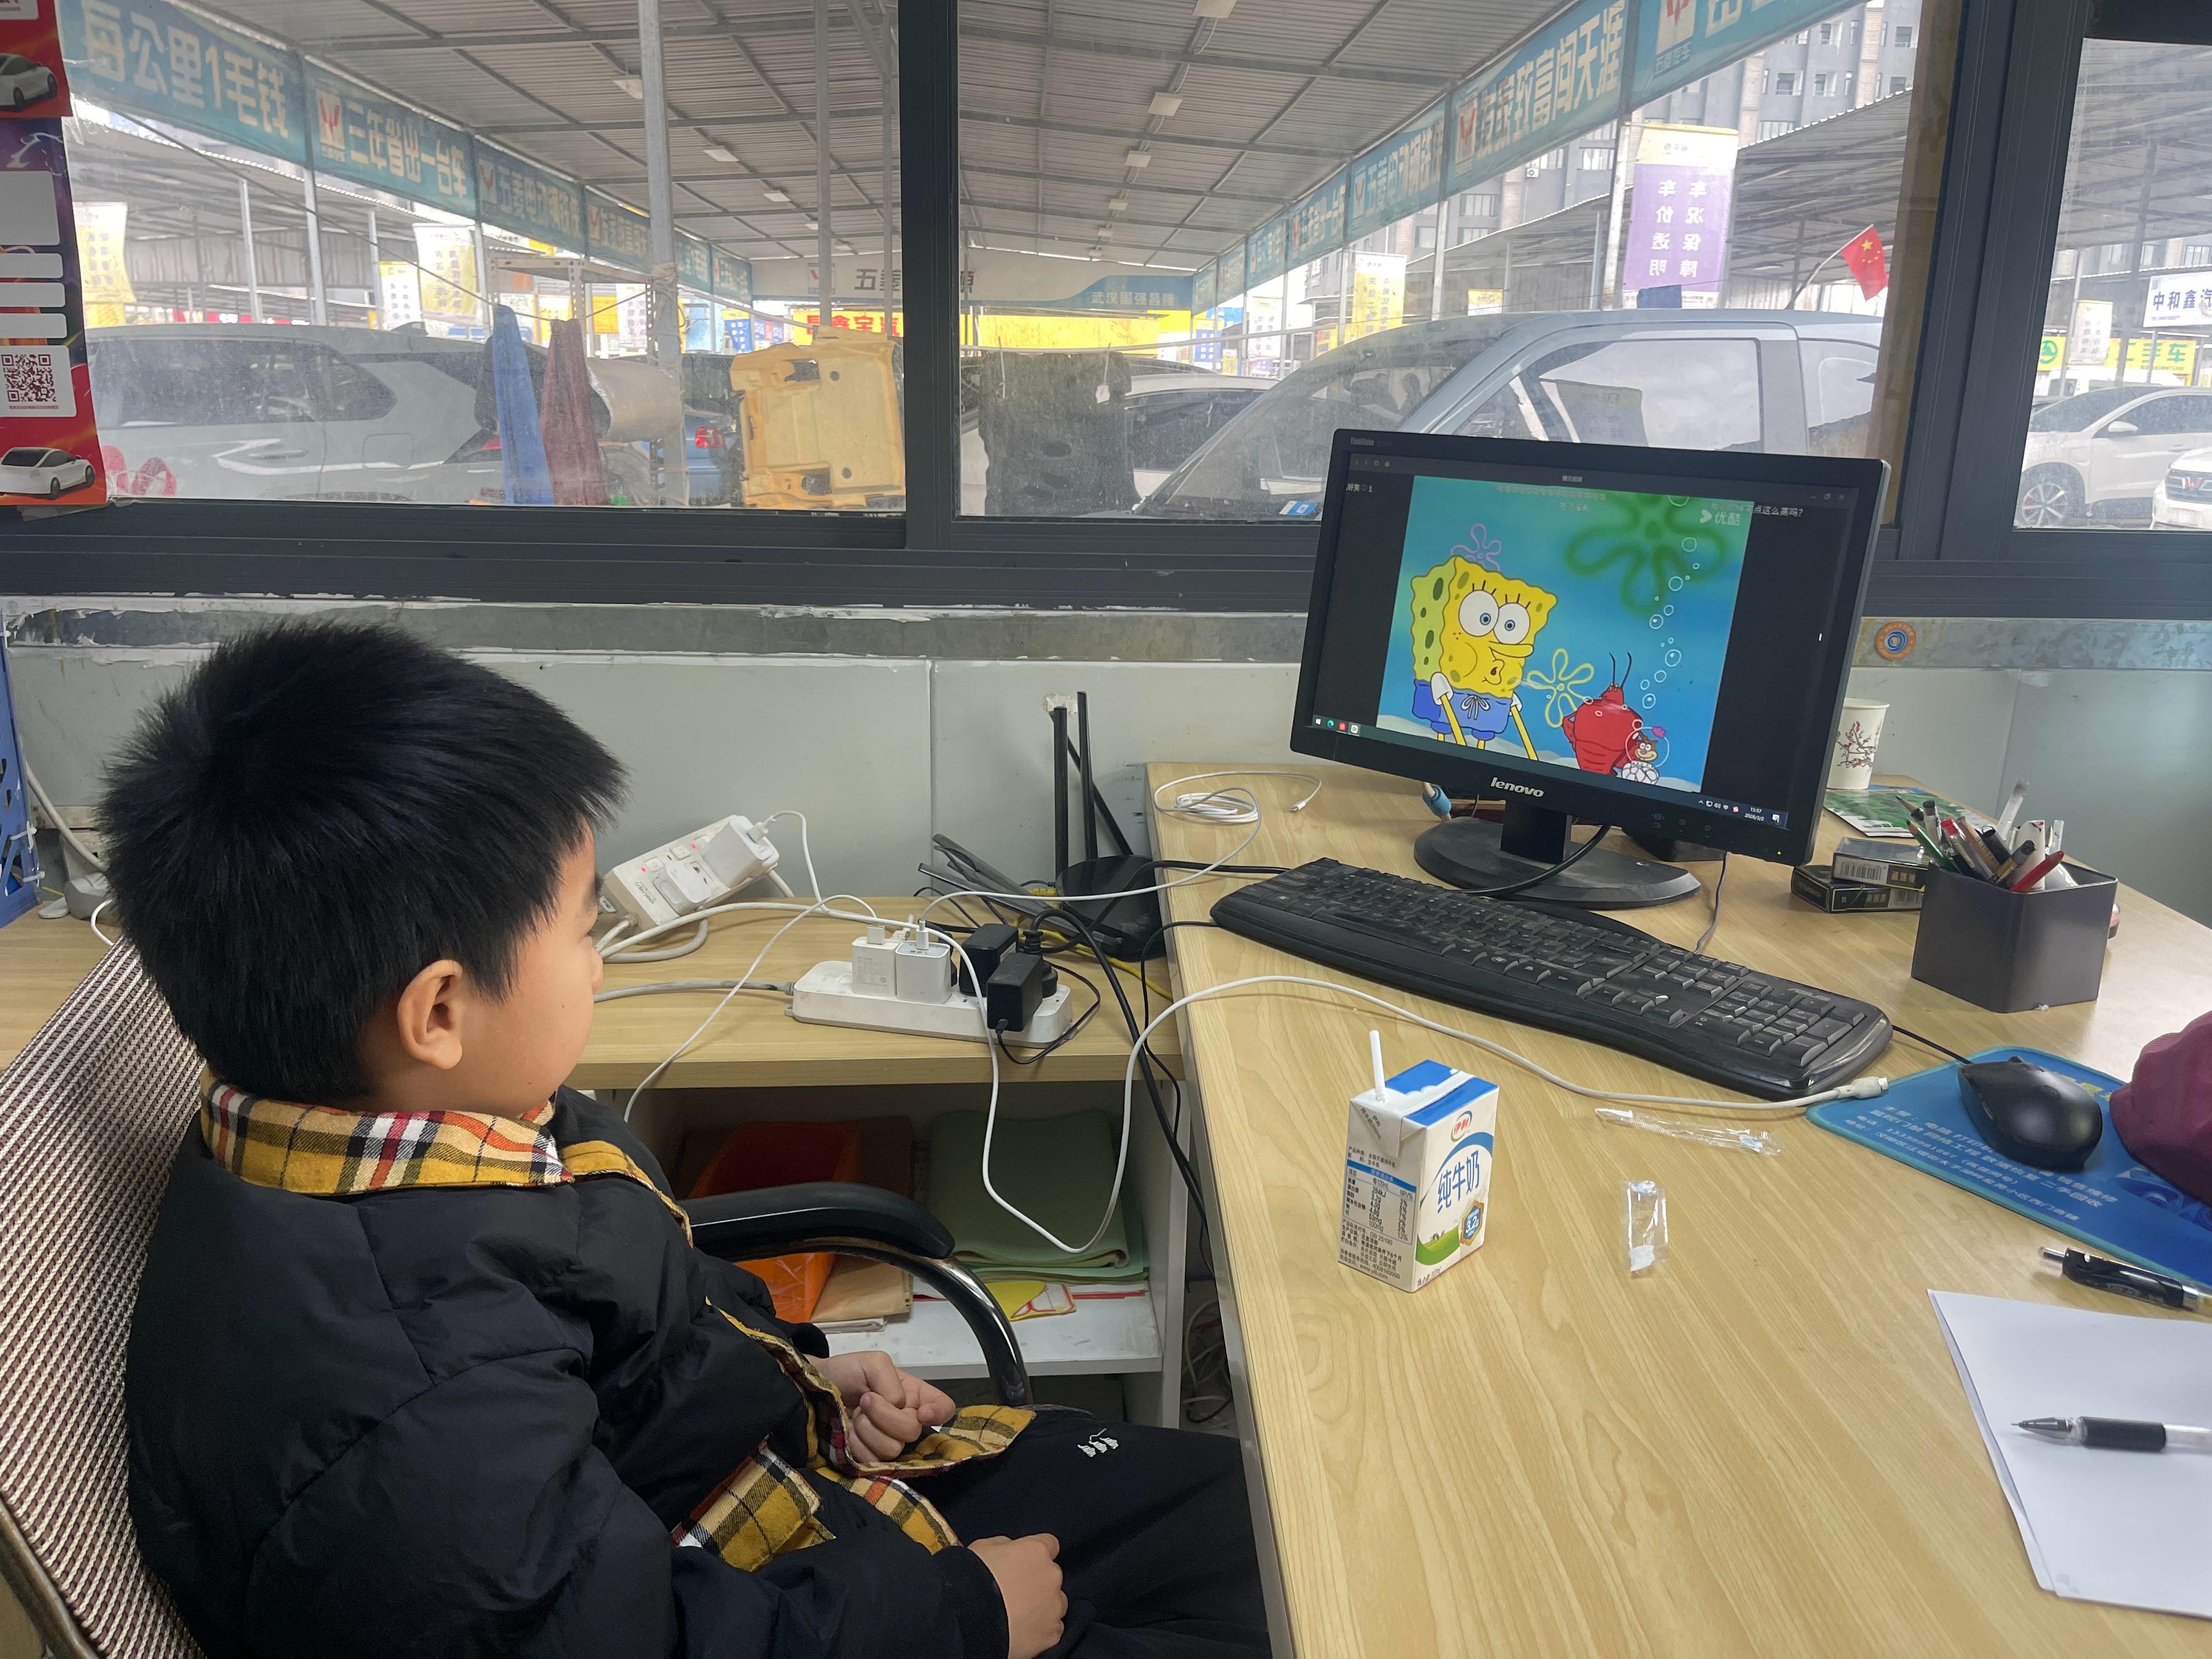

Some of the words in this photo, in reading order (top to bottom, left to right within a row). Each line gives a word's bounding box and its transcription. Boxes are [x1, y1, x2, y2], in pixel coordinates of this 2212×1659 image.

[346, 101, 466, 199] 三年省出一台车
[1091, 292, 1175, 307] 武汉国强昌隆
[2152, 289, 2212, 311] 中和鑫汽
[1714, 511, 1742, 526] 优酷
[1490, 777, 1544, 798] lenovo
[1454, 1117, 1470, 1136] 伊利
[1437, 1150, 1480, 1214] 纯牛奶
